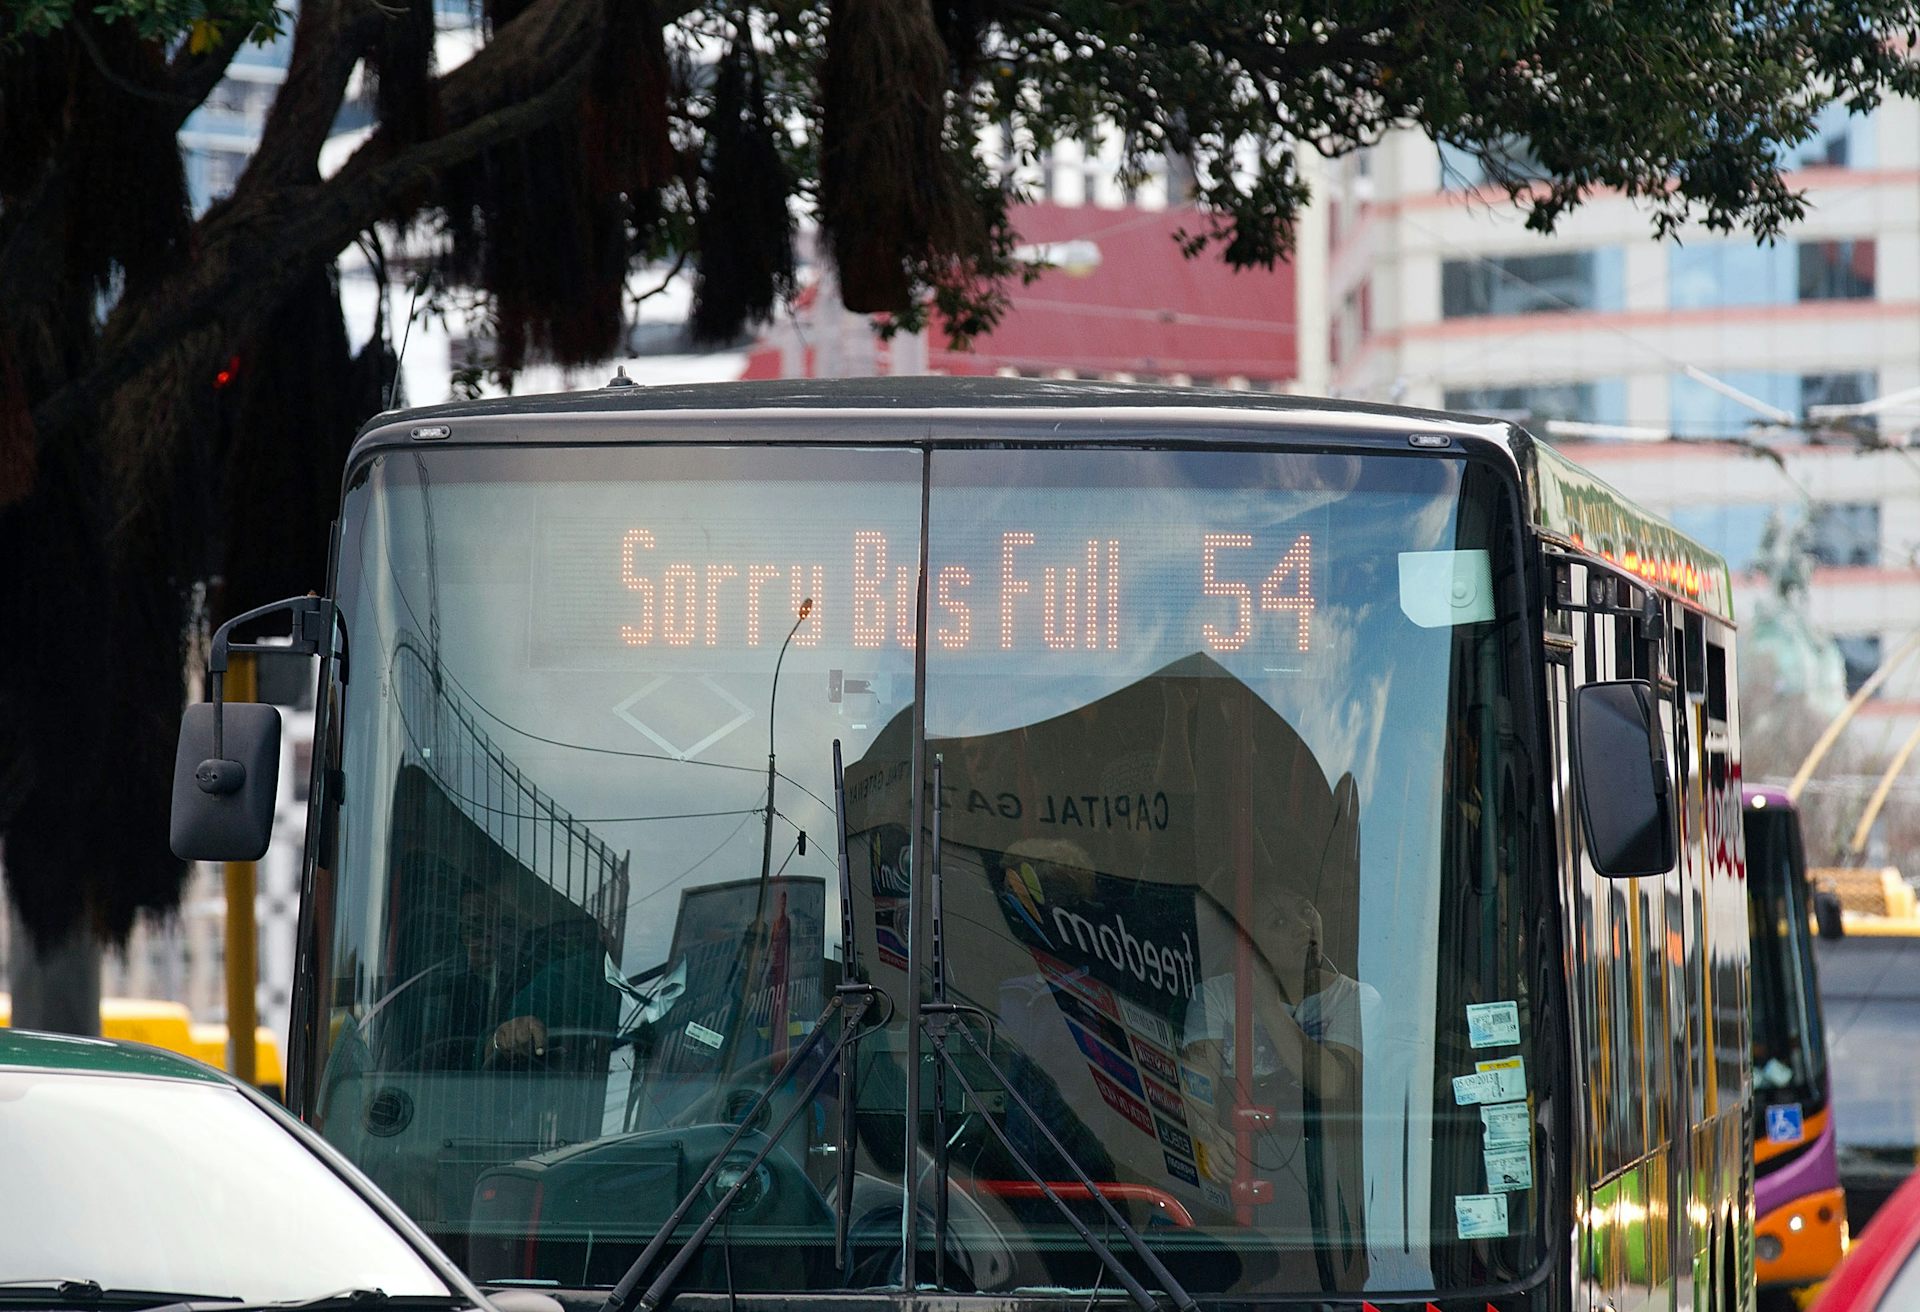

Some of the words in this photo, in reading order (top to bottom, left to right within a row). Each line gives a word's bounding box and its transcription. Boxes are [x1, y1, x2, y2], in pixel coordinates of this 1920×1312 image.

[621, 528, 824, 647] Sorry
[854, 530, 971, 649] Bus
[1002, 531, 1119, 650] Full
[1203, 533, 1316, 652] 54
